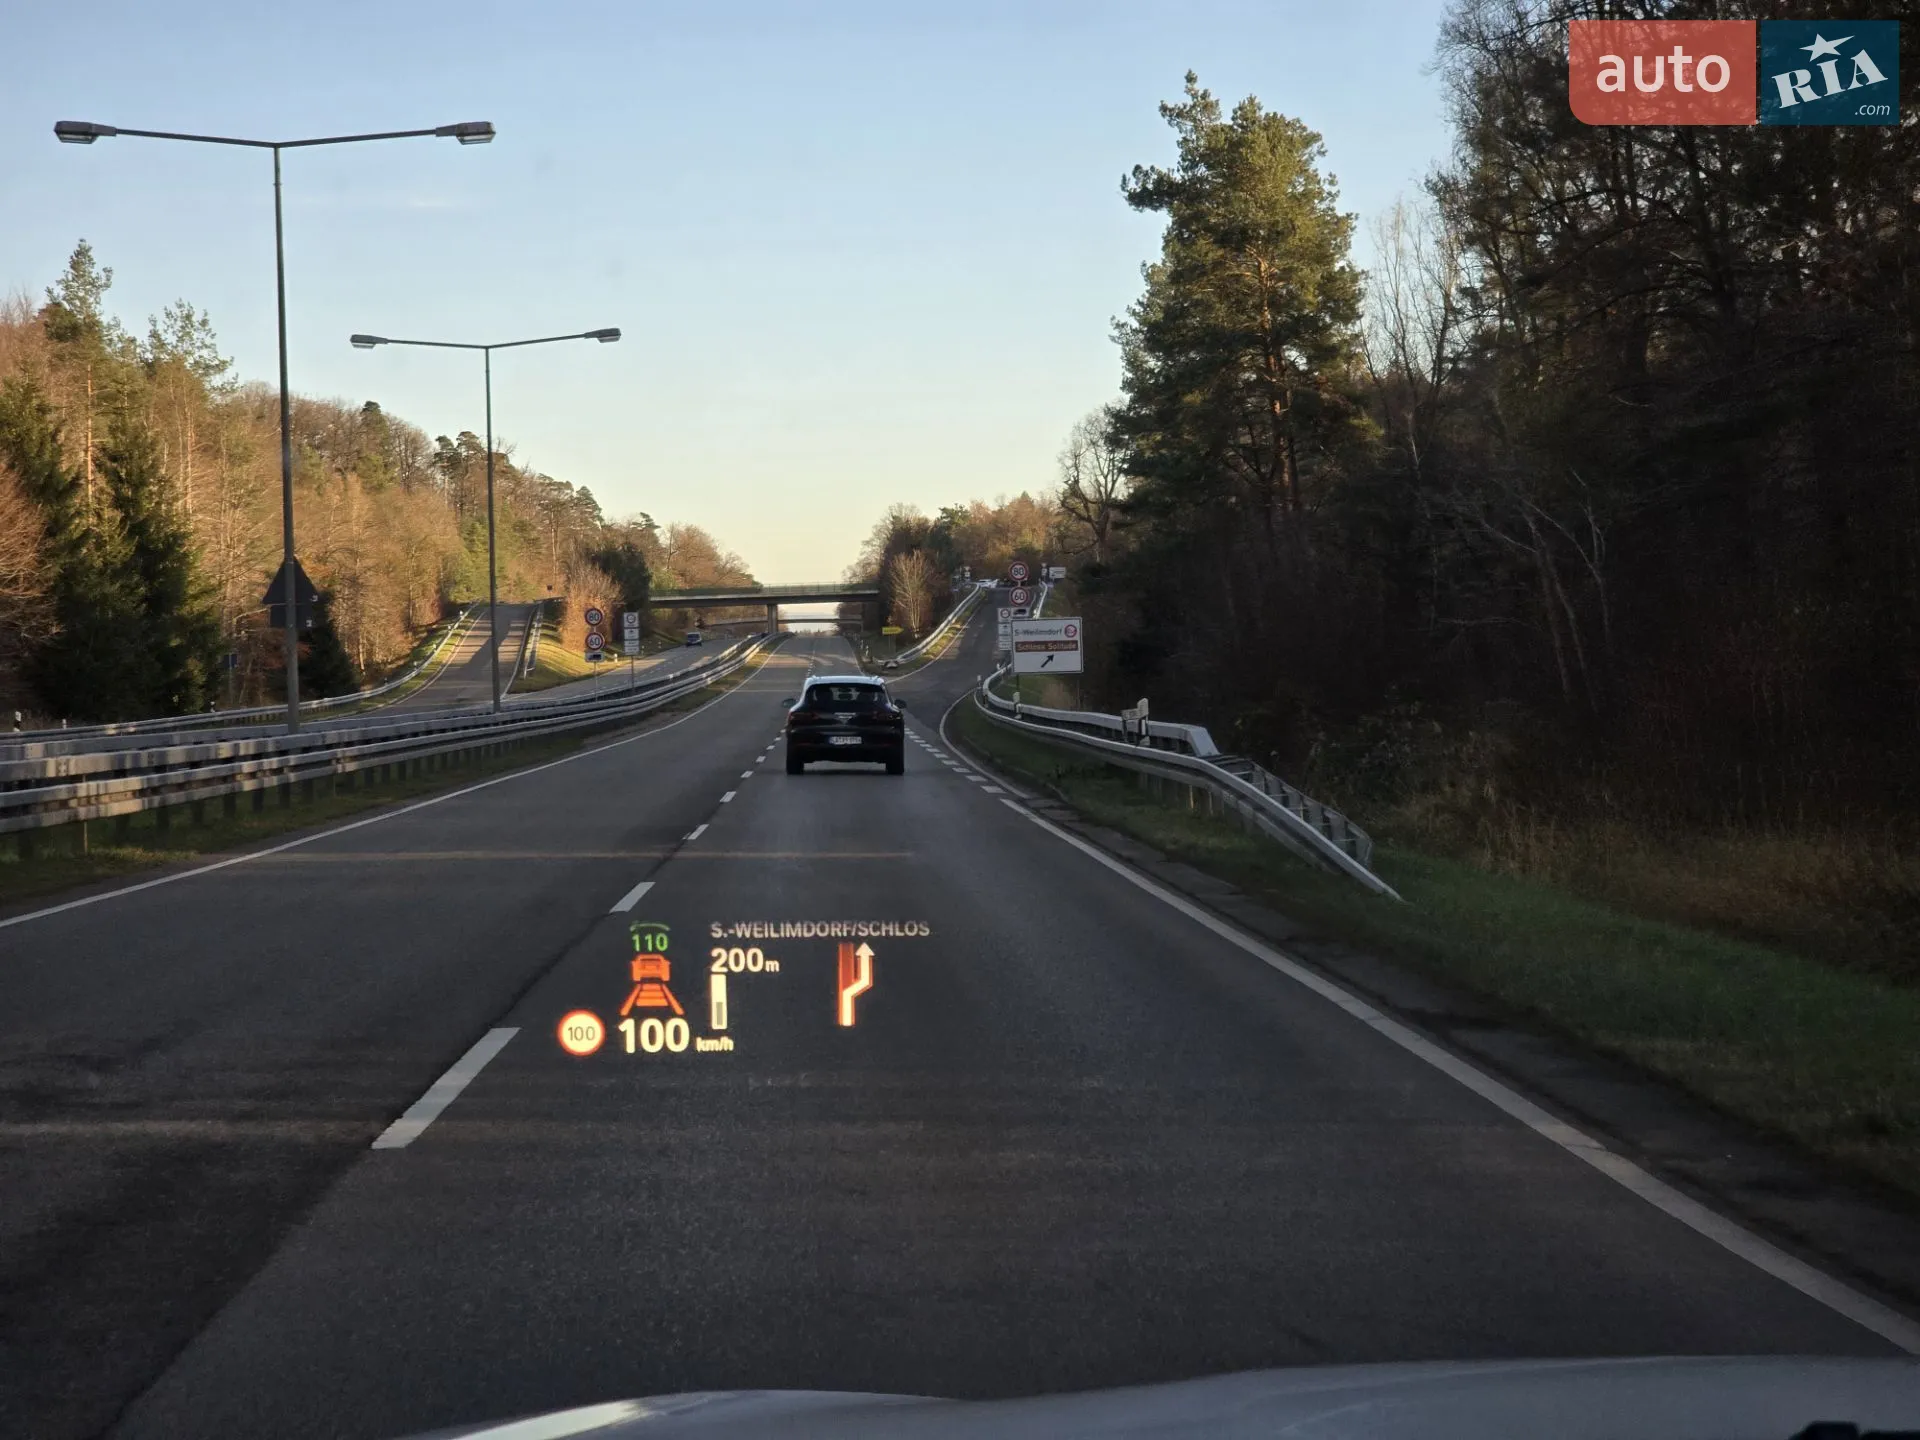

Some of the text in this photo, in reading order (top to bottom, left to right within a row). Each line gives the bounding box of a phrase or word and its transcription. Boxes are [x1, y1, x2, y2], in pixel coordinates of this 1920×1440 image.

[1013, 567, 1025, 576] 80
[1014, 591, 1024, 601] 60
[589, 612, 600, 622] 80
[589, 637, 600, 646] 60
[632, 933, 668, 952] 110
[567, 1026, 596, 1042] 100
[618, 1018, 734, 1053] 100 km/h
